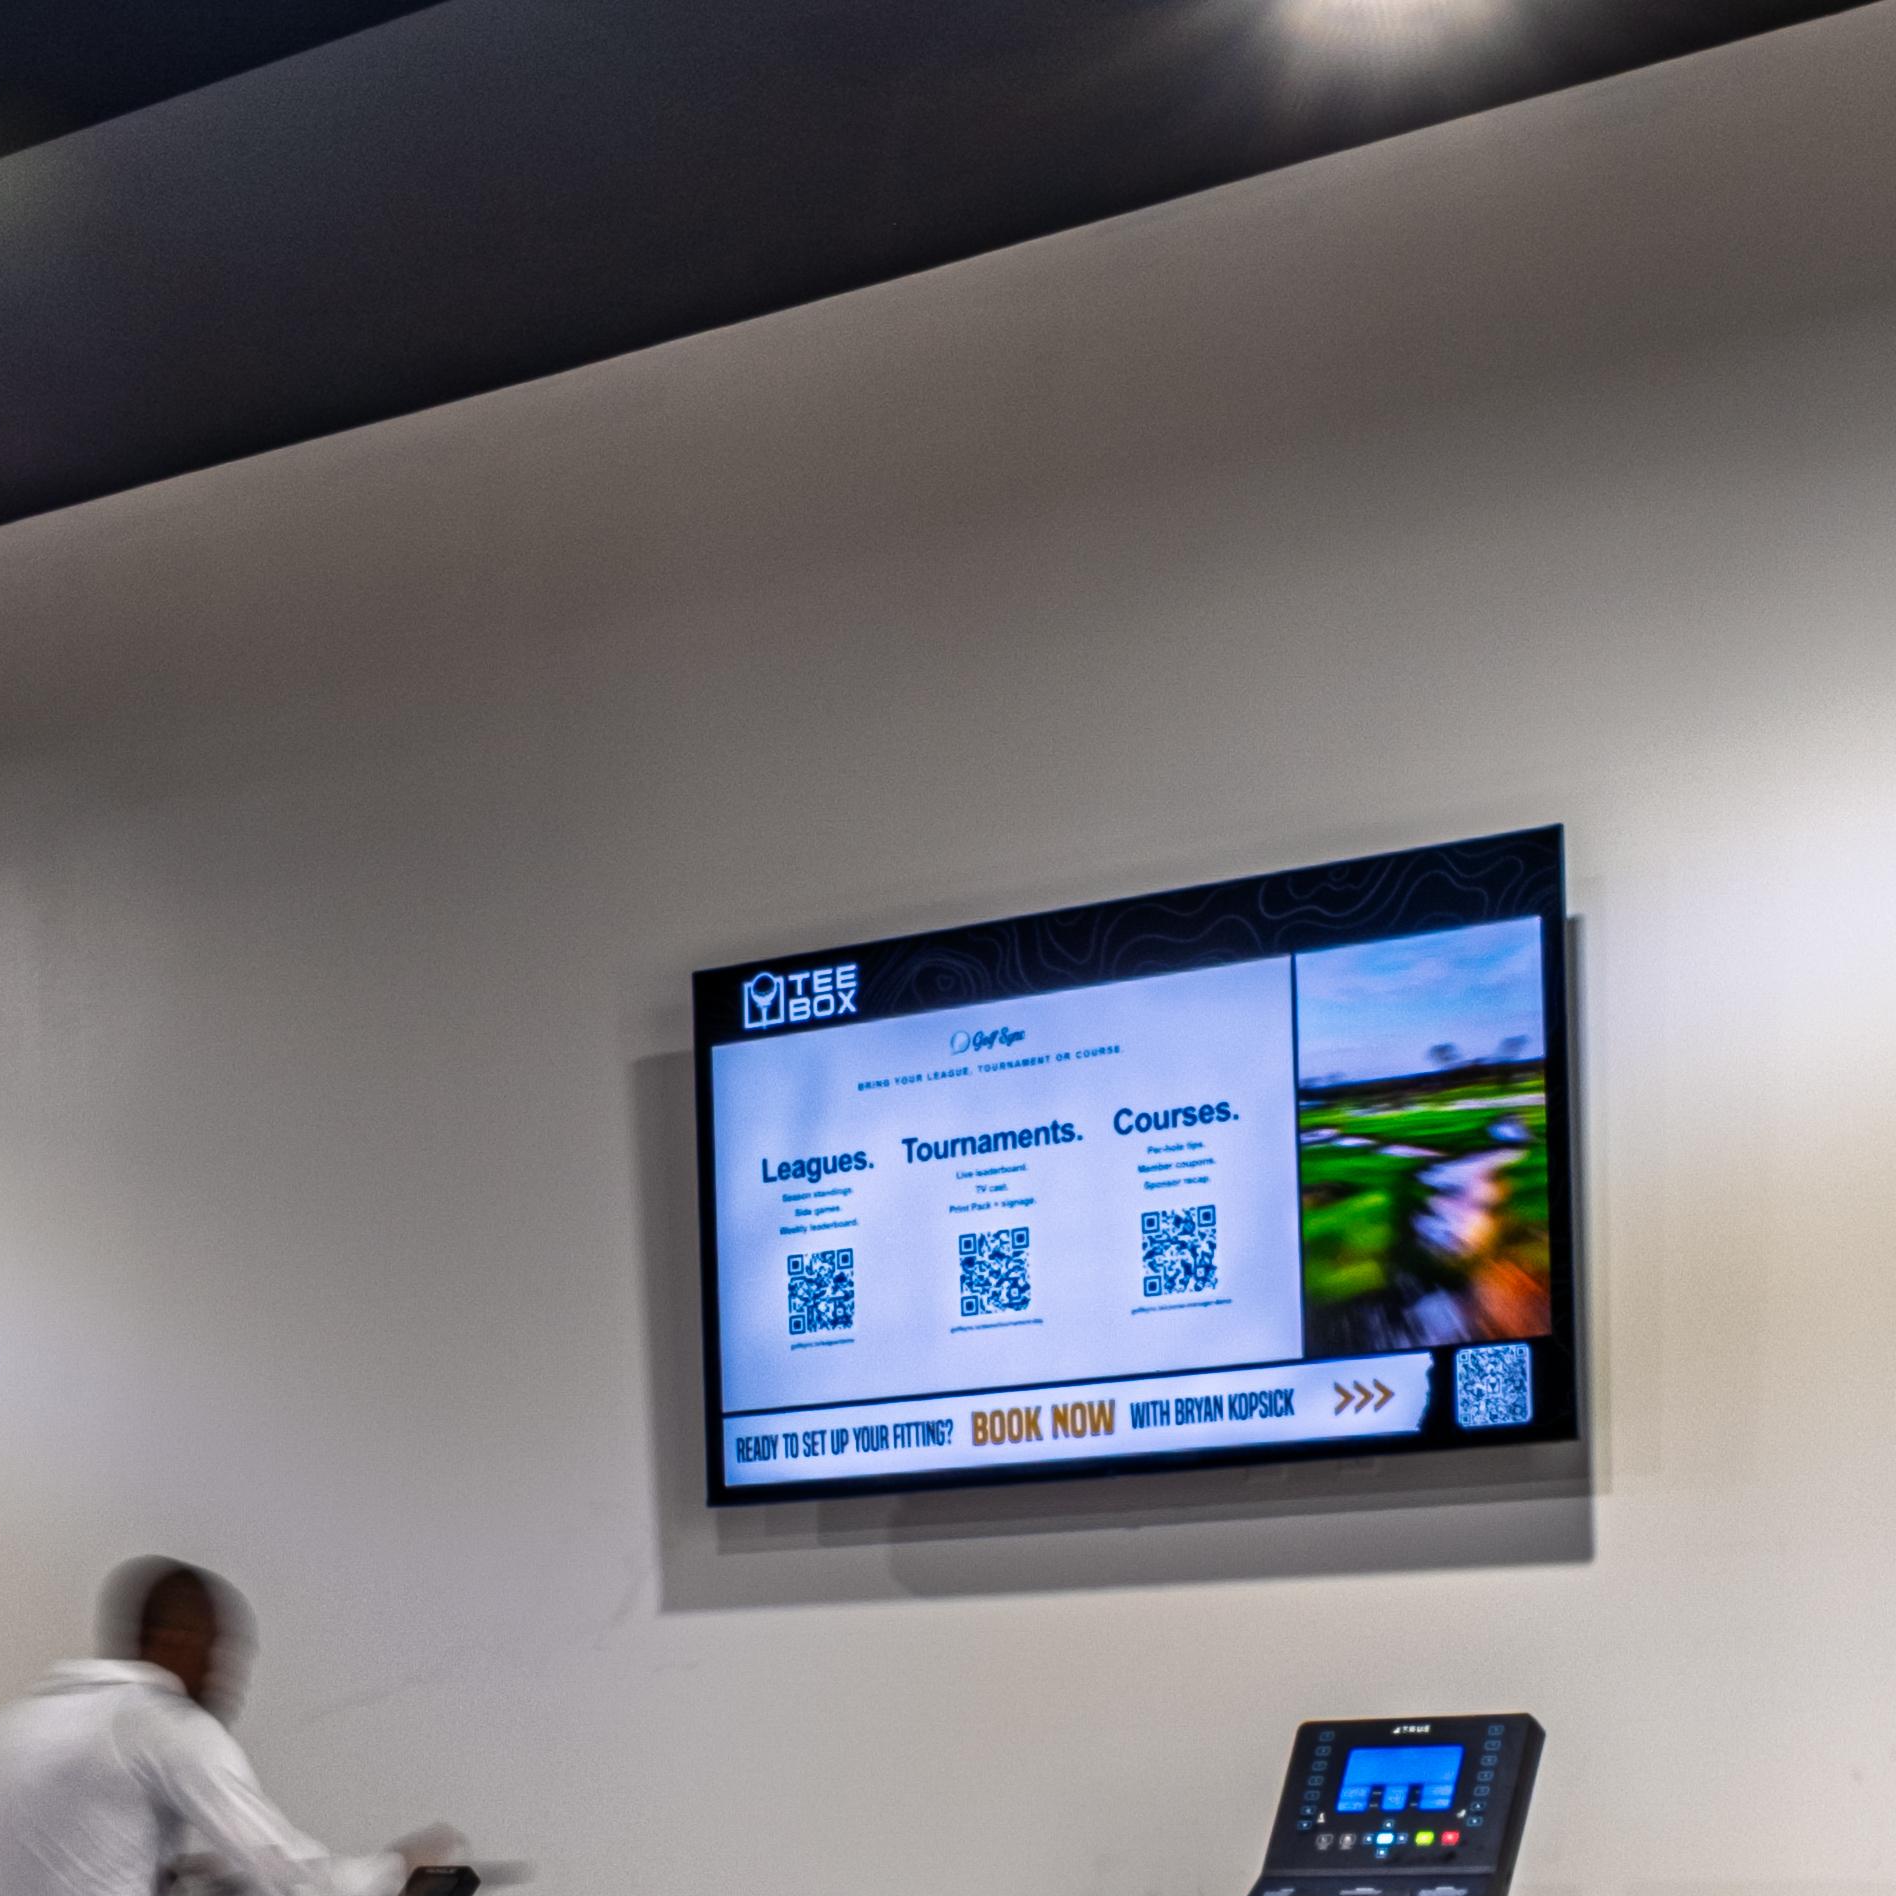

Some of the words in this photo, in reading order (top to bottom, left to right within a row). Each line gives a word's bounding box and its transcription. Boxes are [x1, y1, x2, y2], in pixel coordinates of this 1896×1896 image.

[788, 963, 858, 997] TEE
[788, 989, 858, 1022] BOX
[972, 1027, 998, 1051] Golf
[857, 1078, 892, 1091] BRING
[894, 1073, 923, 1085] YOUR
[977, 1055, 1051, 1073] TOURNAMENT
[1056, 1053, 1071, 1062] OR
[1113, 1100, 1240, 1136] Courses.
[902, 1119, 1084, 1164] Tournaments.
[762, 1150, 875, 1184] Leagues.
[736, 1434, 779, 1464] READY
[783, 1432, 798, 1459] TO
[802, 1429, 827, 1457] SET
[831, 1427, 850, 1455] UP
[853, 1424, 890, 1453] YOUR
[893, 1418, 955, 1449] FITTING?
[971, 1404, 1044, 1447] BOOK
[1051, 1399, 1116, 1440] NOW
[1129, 1401, 1171, 1430] WITH
[1175, 1395, 1224, 1427] BRYAN
[1227, 1388, 1296, 1421] KOPSICK
